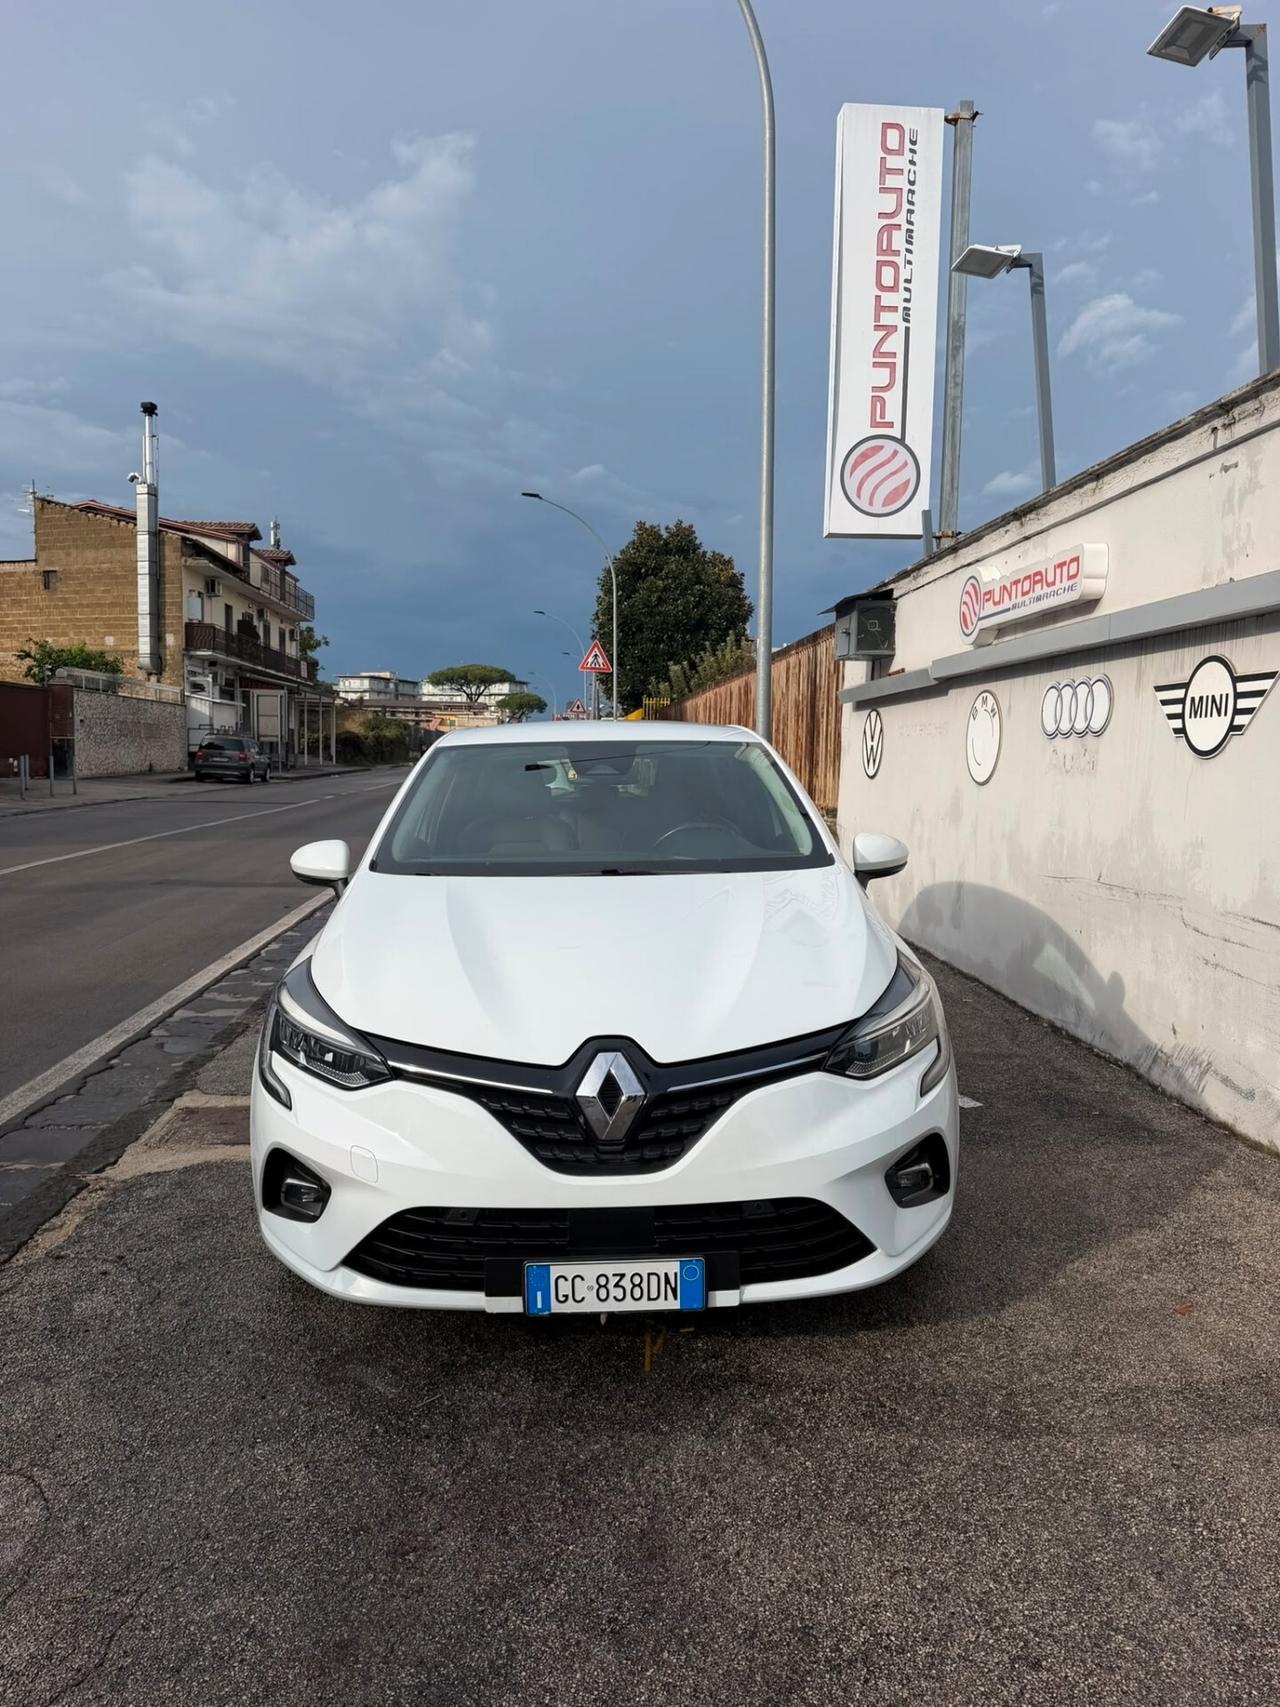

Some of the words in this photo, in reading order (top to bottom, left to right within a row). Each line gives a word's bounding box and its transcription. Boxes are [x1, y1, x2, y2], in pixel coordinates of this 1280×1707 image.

[902, 127, 919, 325] MULTIMARCHE
[870, 122, 906, 429] PUNTOAUTO
[982, 555, 1080, 611] PUNTOAUTO
[1011, 582, 1078, 611] MULTIMARCHE
[971, 695, 998, 721] BMW
[1188, 692, 1230, 720] MINI
